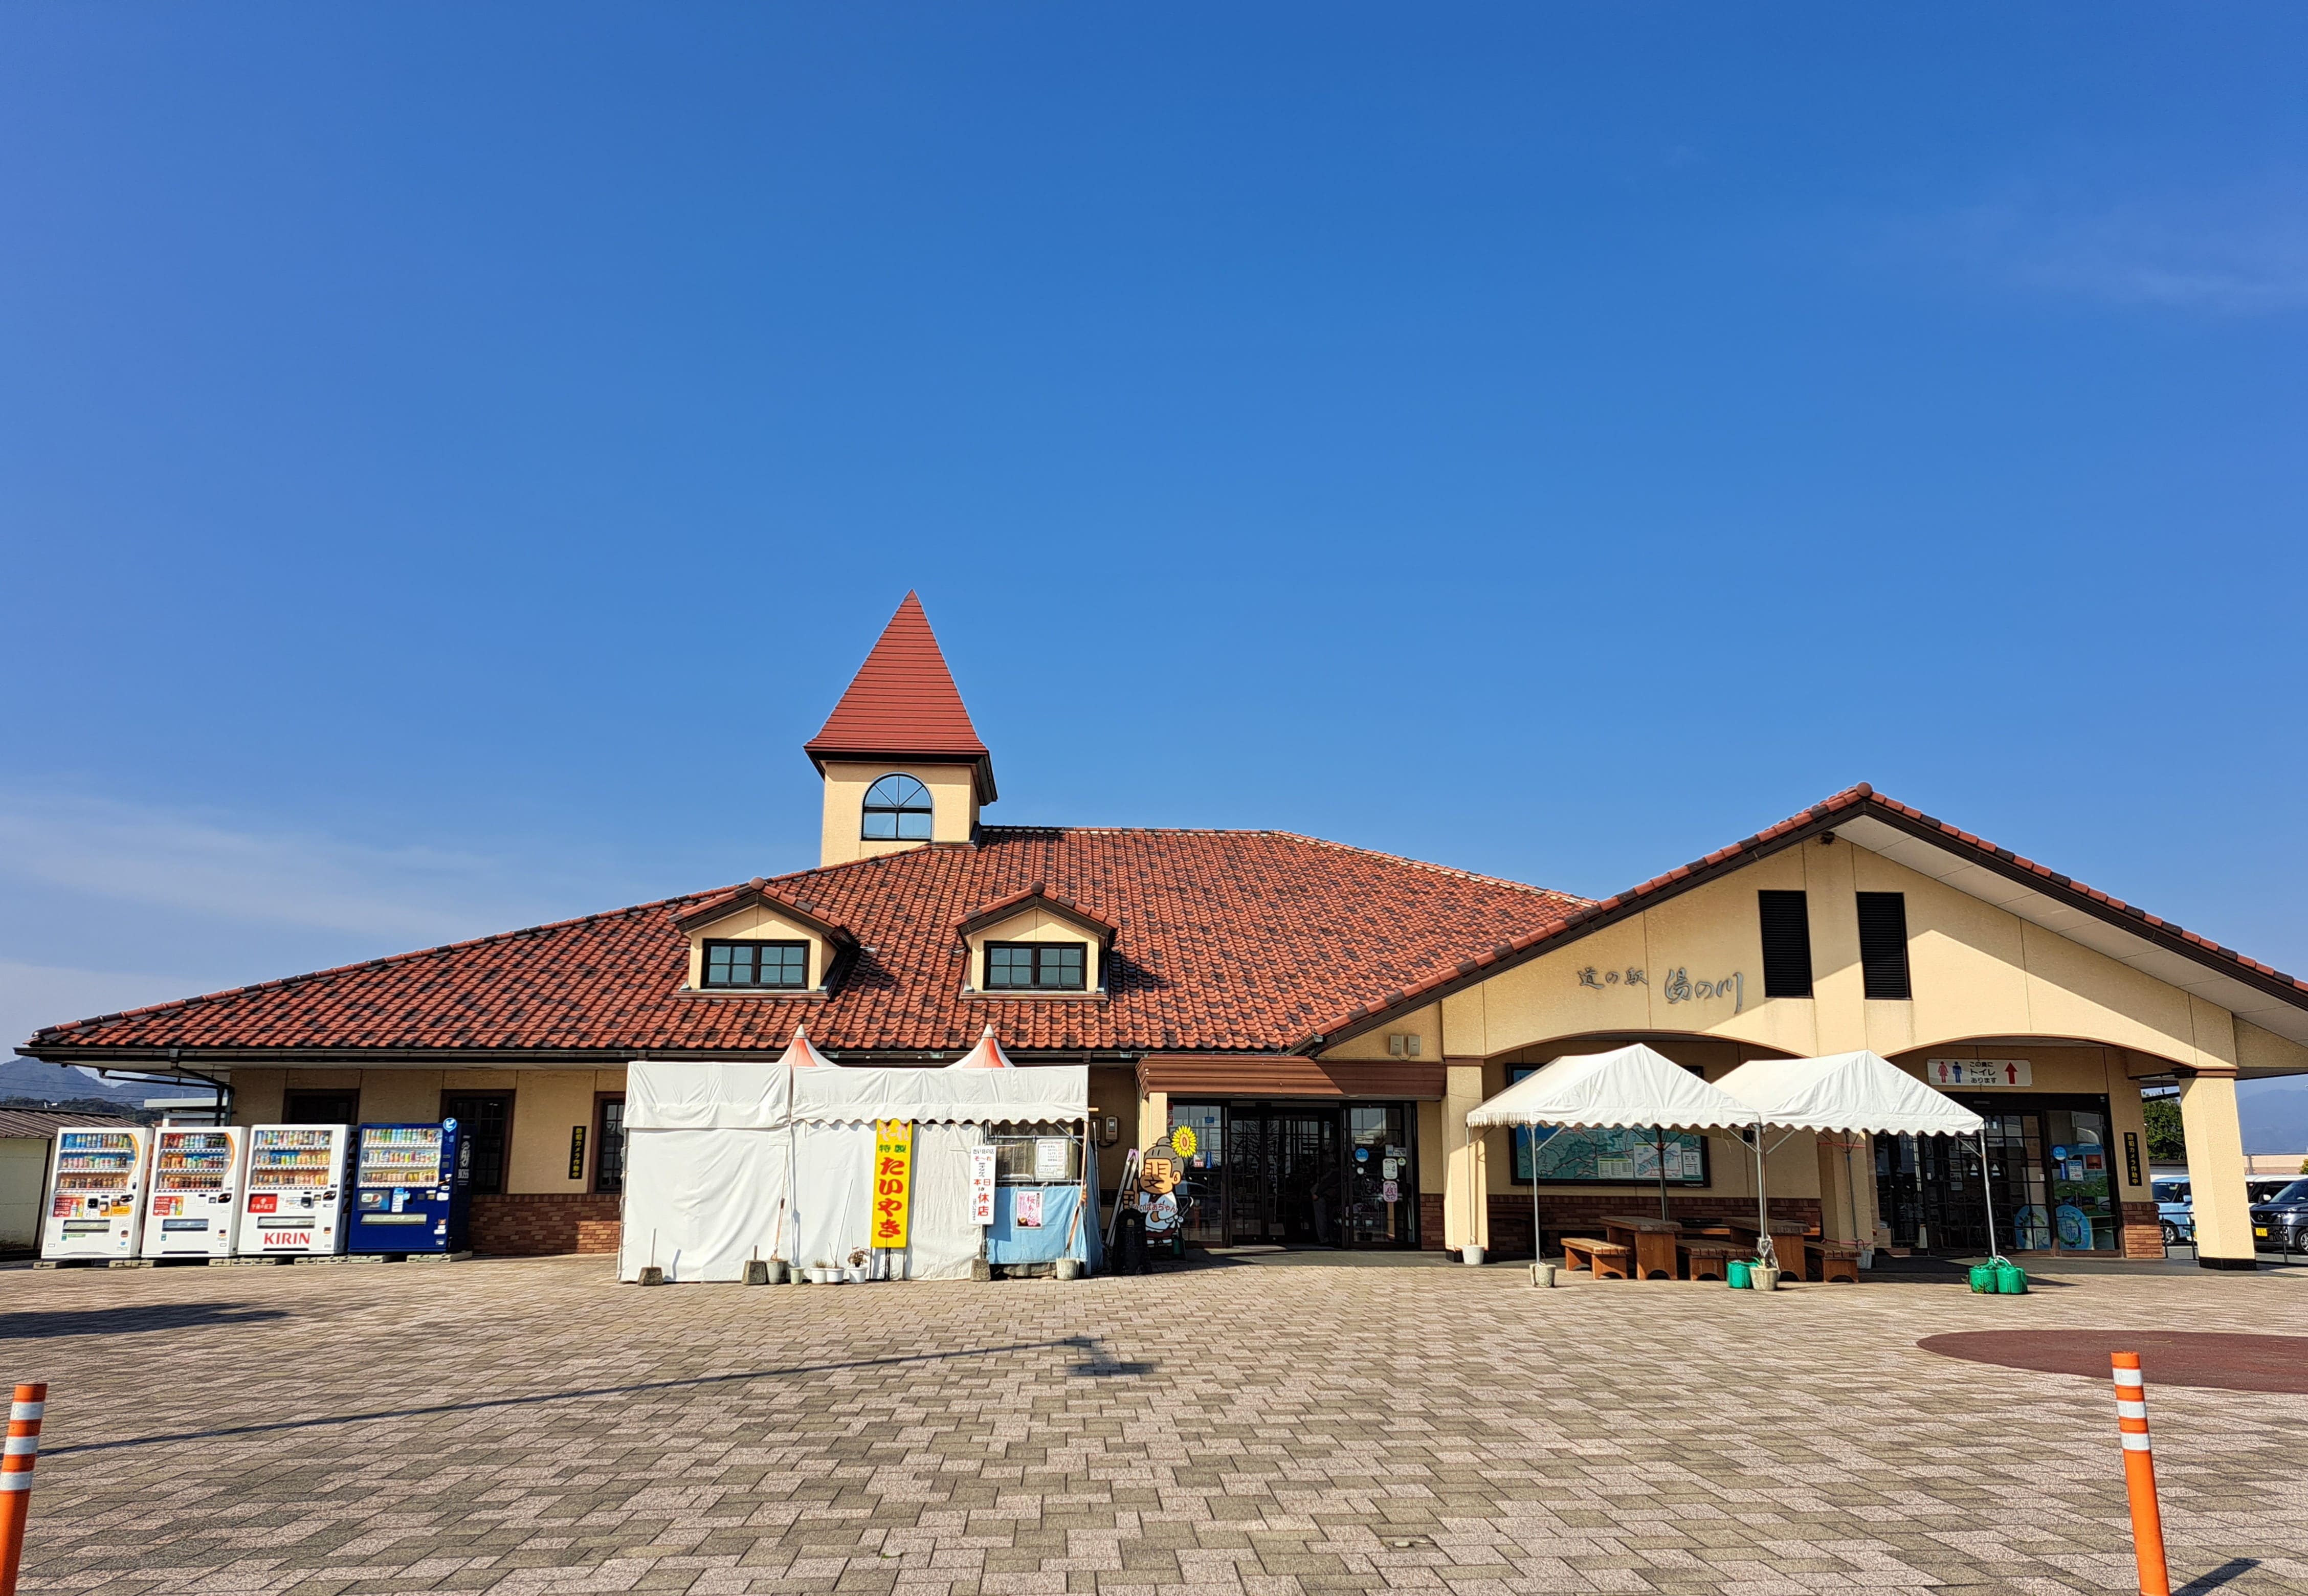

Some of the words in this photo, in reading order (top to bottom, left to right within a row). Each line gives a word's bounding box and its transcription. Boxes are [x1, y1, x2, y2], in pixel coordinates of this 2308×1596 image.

[1577, 966, 1648, 989] 道の駅
[1665, 967, 1743, 1014] 湯の川
[878, 1144, 906, 1153] 特製
[877, 1157, 905, 1238] たいやき
[978, 1192, 989, 1216] 休店
[264, 1232, 311, 1245] KIRIN
